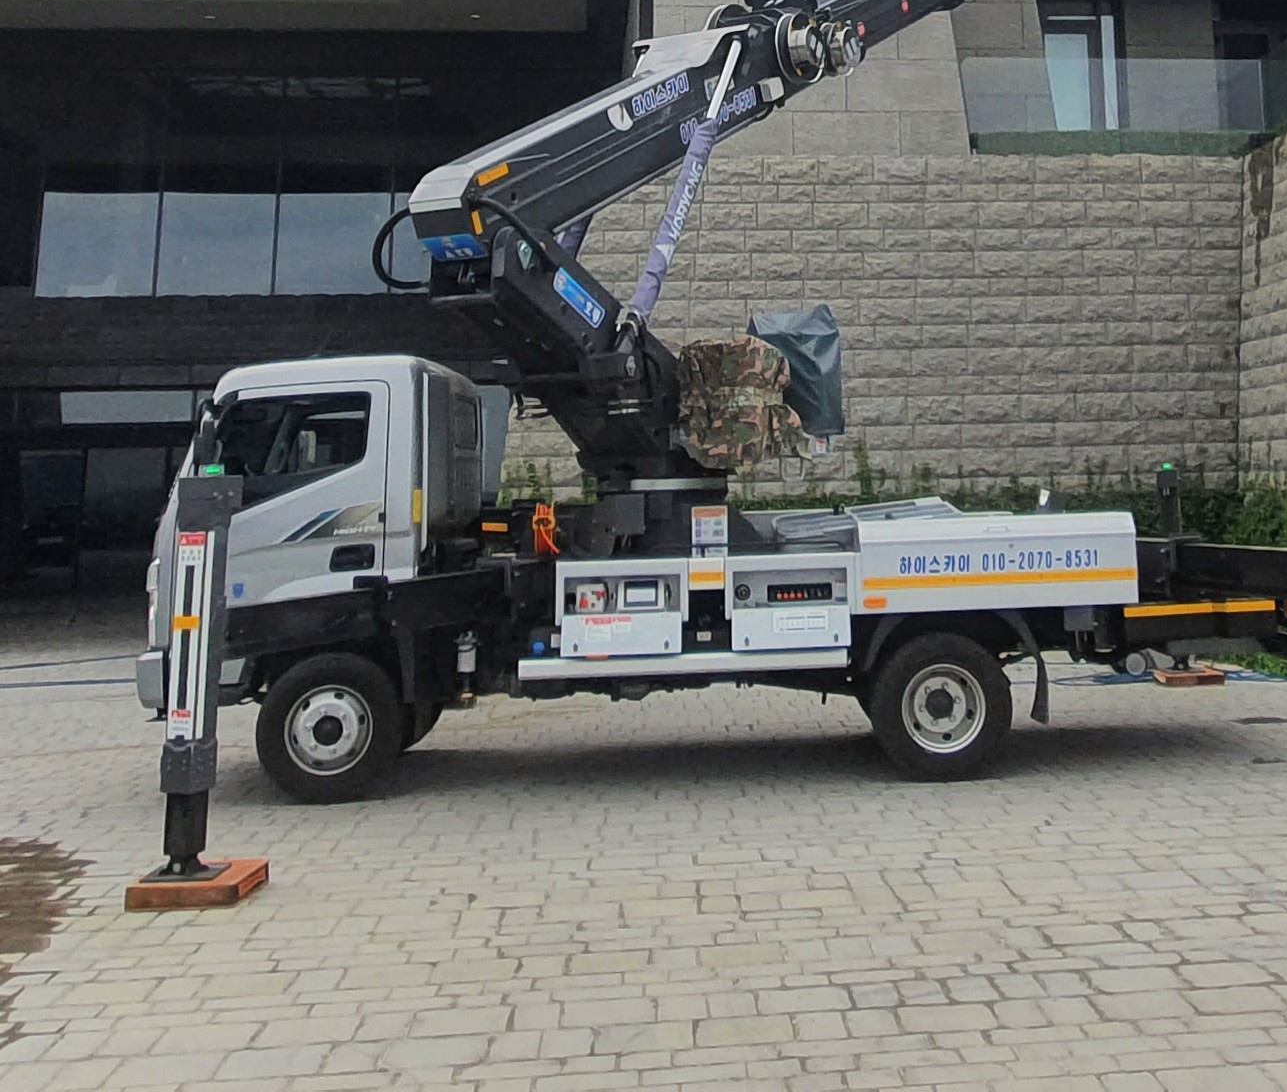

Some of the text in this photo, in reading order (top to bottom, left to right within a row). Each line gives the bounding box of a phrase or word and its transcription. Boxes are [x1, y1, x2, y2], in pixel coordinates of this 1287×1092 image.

[631, 71, 690, 117] 하이스카이
[899, 549, 1099, 575] 하이스카이 010-2070-8531
